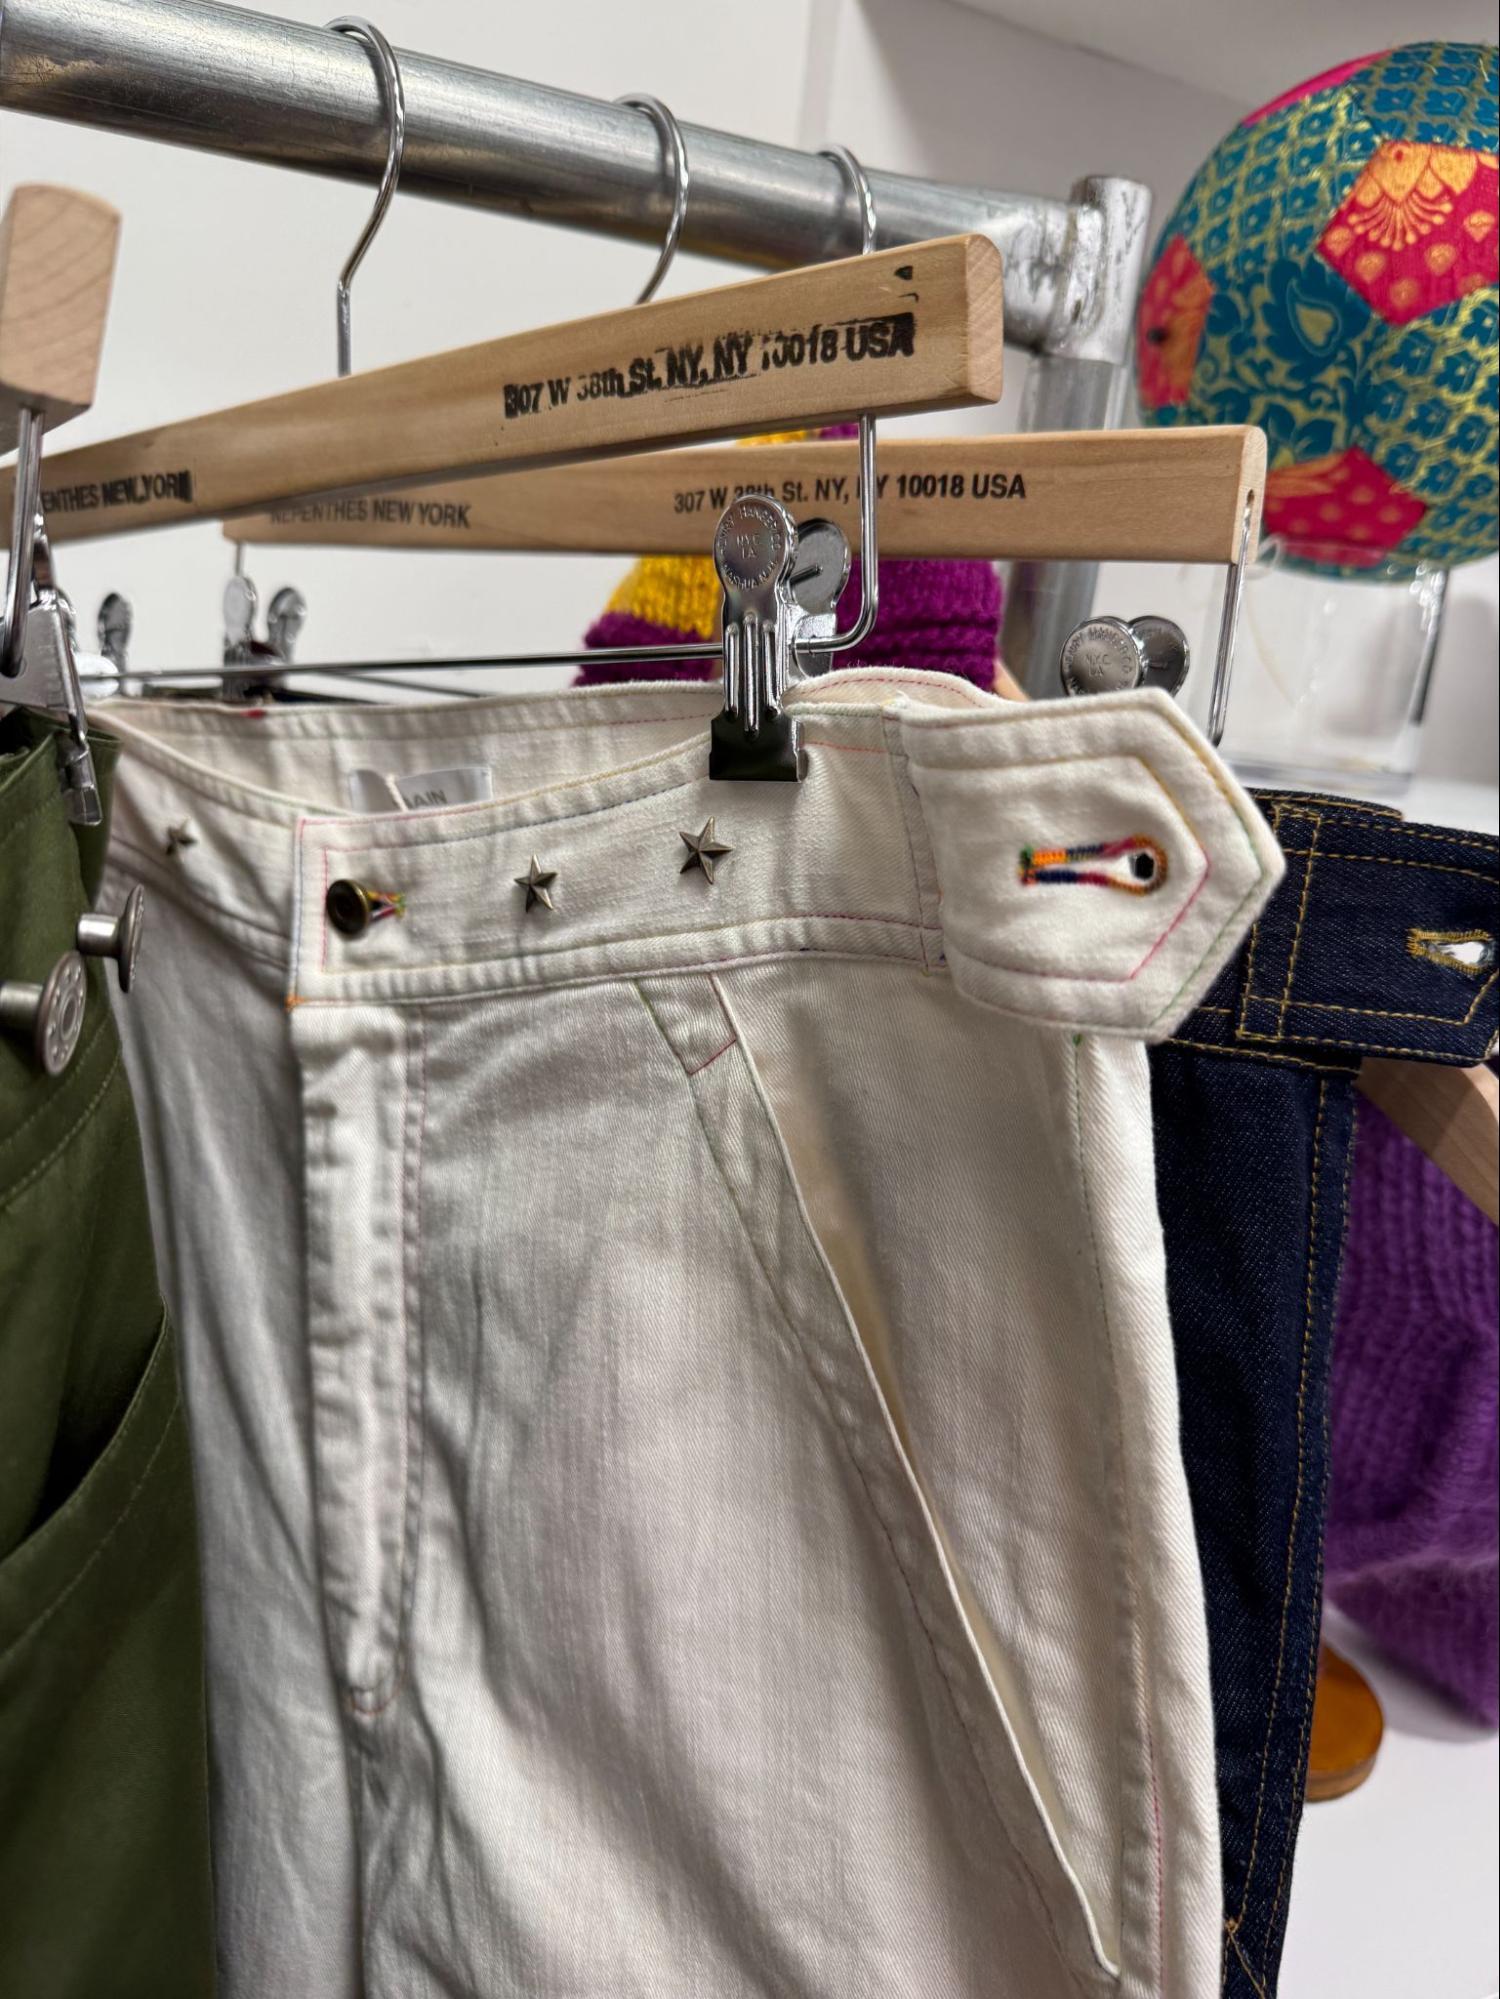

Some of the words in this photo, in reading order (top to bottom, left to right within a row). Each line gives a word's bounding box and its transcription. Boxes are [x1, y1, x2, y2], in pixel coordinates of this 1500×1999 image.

[547, 376, 571, 407] W
[713, 331, 753, 380] NY
[846, 313, 915, 361] USA
[373, 499, 414, 525] NEW
[418, 503, 472, 529] YORK
[675, 490, 705, 514] 307
[709, 486, 728, 510] W
[782, 481, 809, 503] St.
[816, 477, 849, 505] NY,
[897, 474, 965, 498] 10018
[972, 473, 1026, 499] USA
